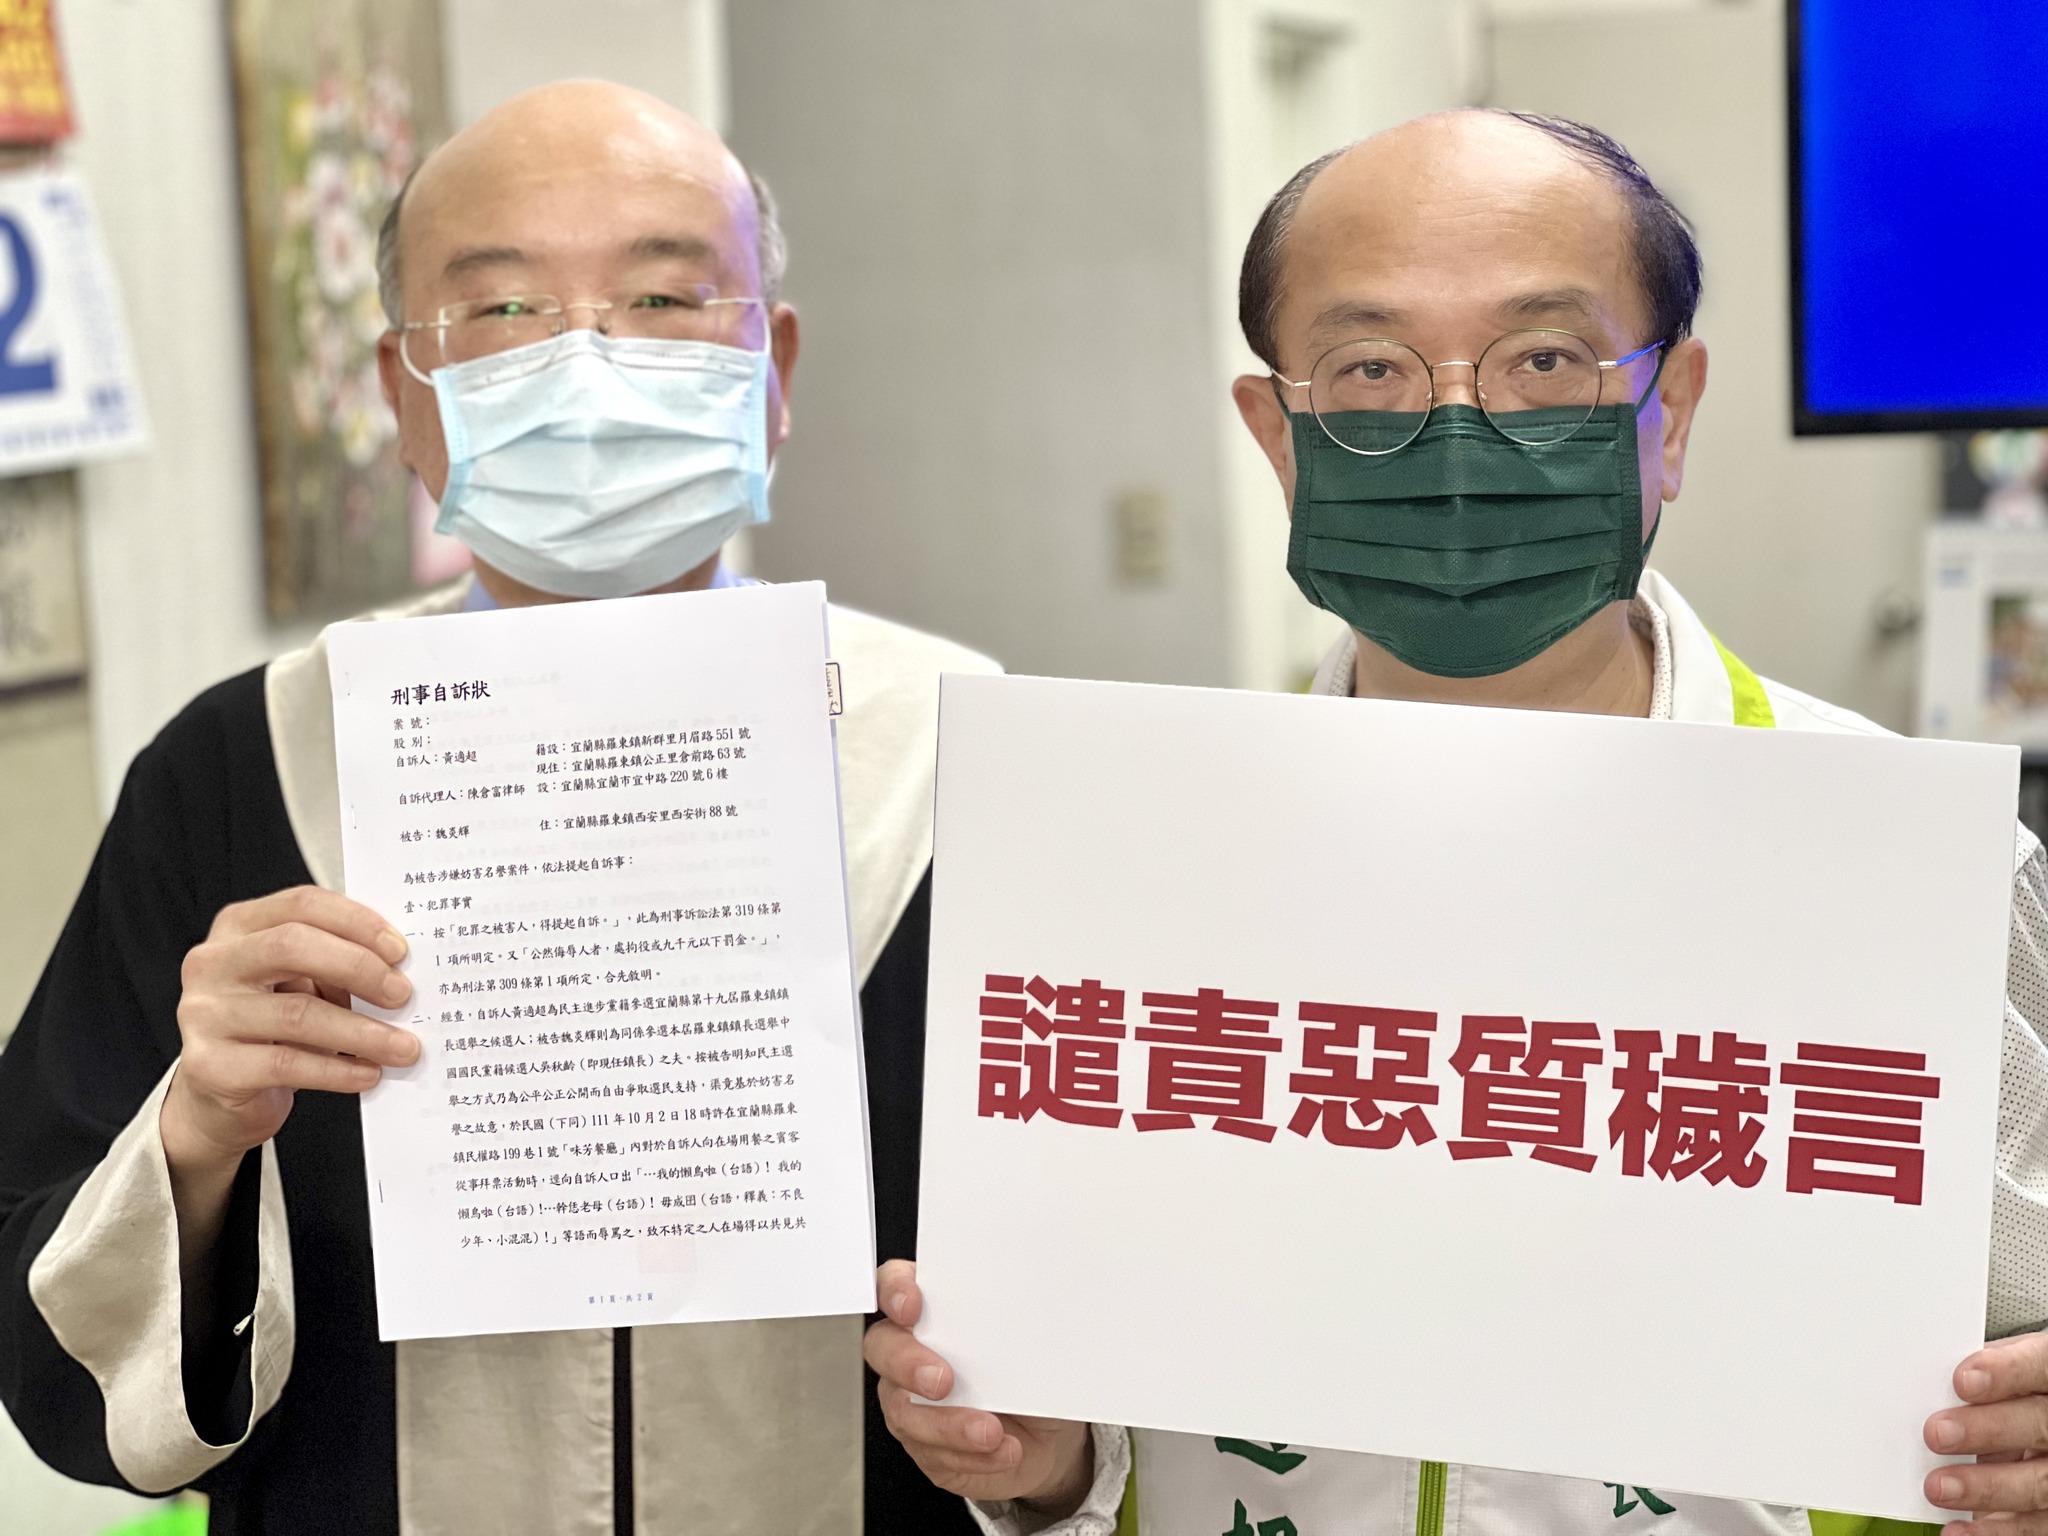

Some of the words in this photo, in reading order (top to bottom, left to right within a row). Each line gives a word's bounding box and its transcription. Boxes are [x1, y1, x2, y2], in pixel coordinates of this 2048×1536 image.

[390, 680, 492, 705] 刑事自訴狀
[978, 974, 1941, 1206] 譴責惡質穢言
